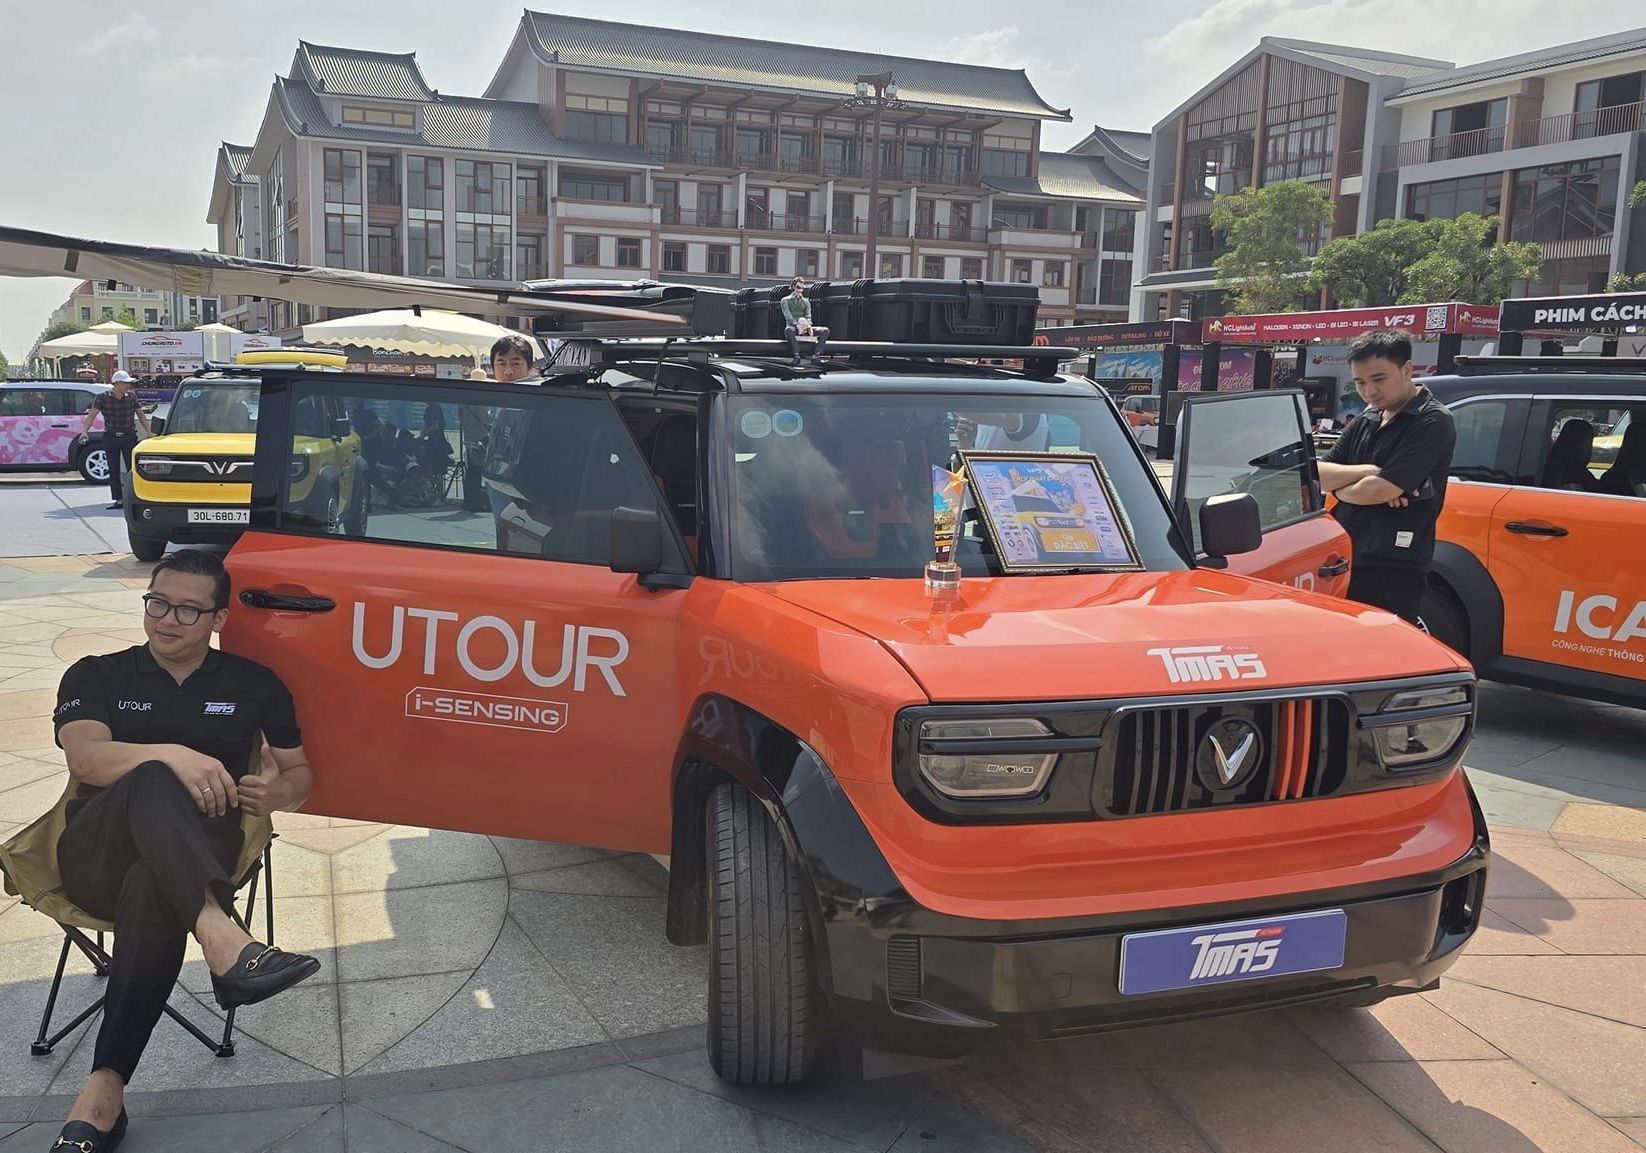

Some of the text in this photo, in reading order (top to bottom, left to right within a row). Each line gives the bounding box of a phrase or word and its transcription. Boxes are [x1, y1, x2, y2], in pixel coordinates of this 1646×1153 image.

[1384, 314, 1415, 327] VF3
[1534, 302, 1646, 323] PHIM CÁCH
[352, 601, 630, 697] UTOUR
[1608, 648, 1644, 663] THÔNG
[118, 700, 152, 711] UTOUR
[414, 694, 560, 726] i-SENSING
